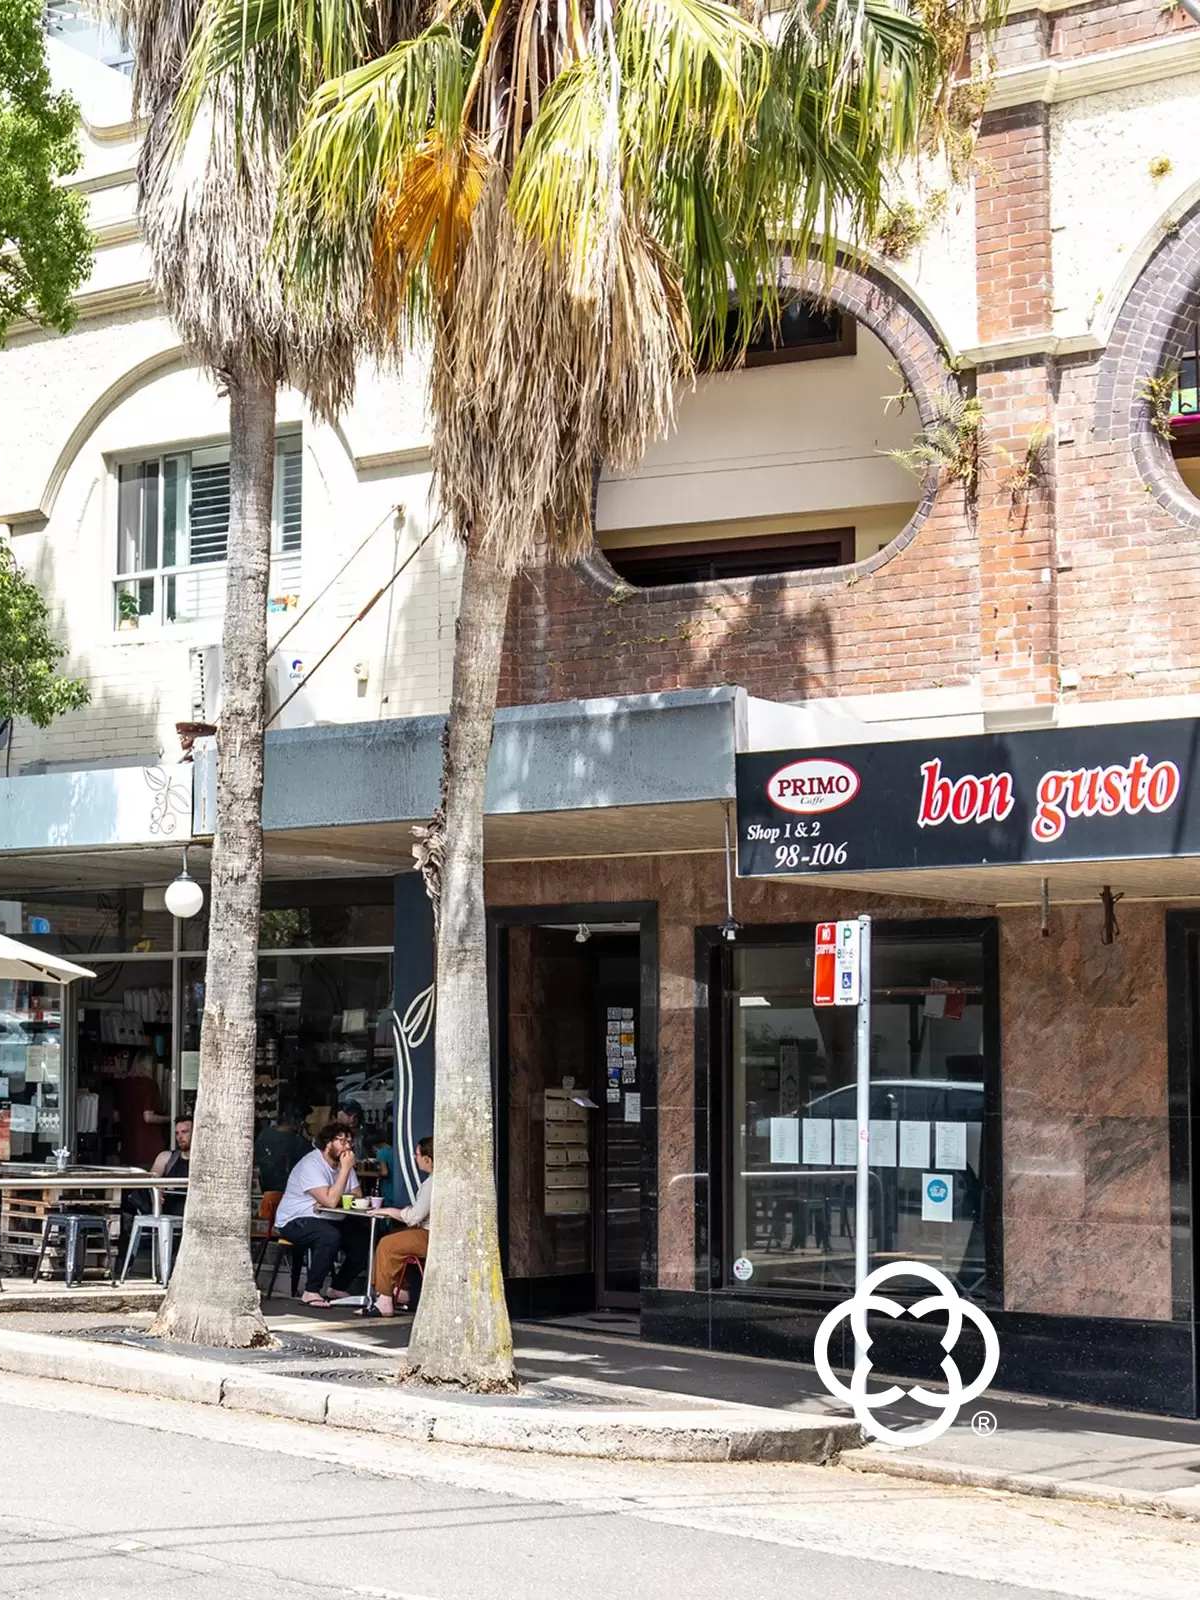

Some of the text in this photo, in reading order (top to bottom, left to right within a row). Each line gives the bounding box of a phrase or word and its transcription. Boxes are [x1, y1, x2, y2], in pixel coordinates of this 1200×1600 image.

[777, 775, 851, 797] PRIMO
[917, 754, 1180, 843] bon gusto
[747, 821, 821, 844] Shop 1 & 2
[774, 841, 848, 868] 98-106
[821, 928, 831, 941] NO
[843, 927, 852, 946] P
